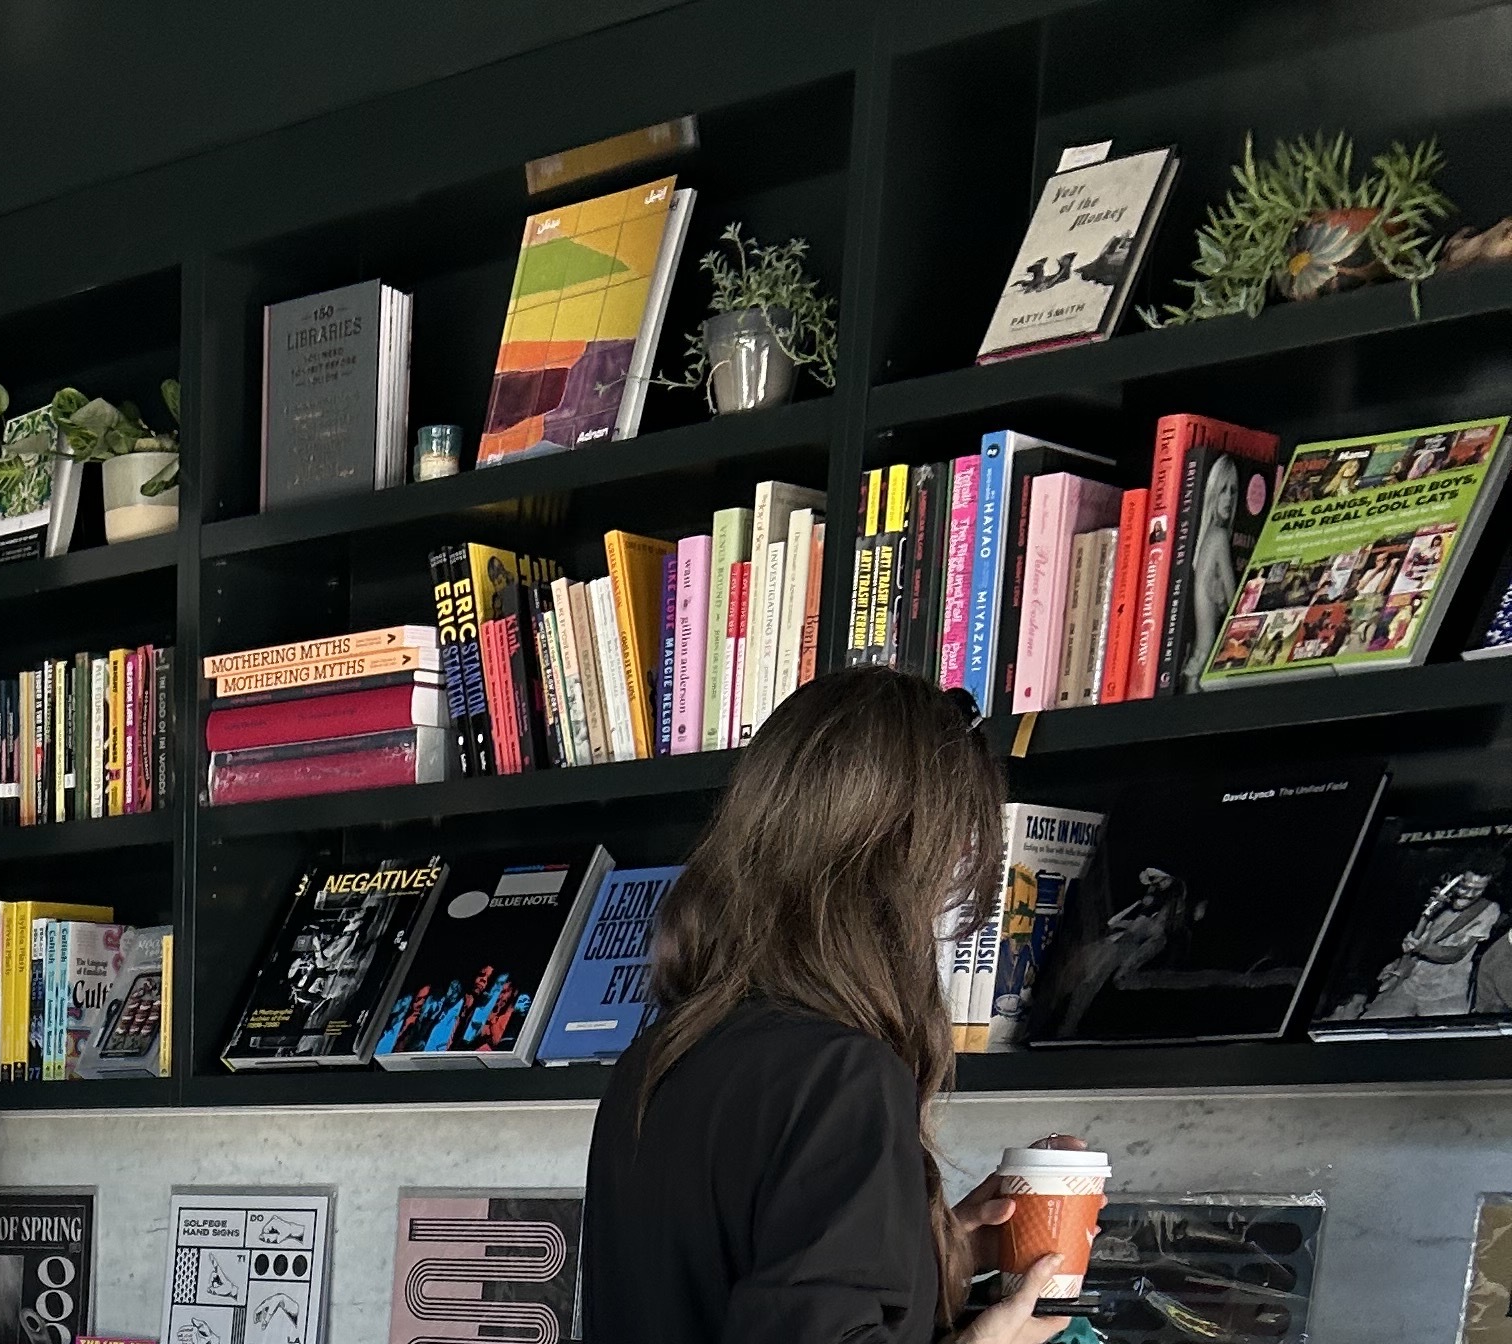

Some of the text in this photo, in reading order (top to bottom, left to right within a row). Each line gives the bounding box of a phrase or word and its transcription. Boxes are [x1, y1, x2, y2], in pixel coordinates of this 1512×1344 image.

[1052, 184, 1086, 204] Year
[1069, 205, 1129, 231] Monkey
[1010, 303, 1086, 326] PATTI SMITH
[287, 317, 363, 350] LIBRARIES
[1271, 474, 1477, 523] GIRL GANGS, BIKER BOYS,
[1279, 489, 1459, 534] AND REAL COOL CATS
[970, 502, 995, 673] HAYAO MIYAZAKI
[211, 638, 351, 674] MOTHERING MYTHS
[434, 582, 466, 719] ERIC STANTON
[453, 578, 486, 716] ERIC STANTON
[661, 560, 677, 743] LIKE LOVE MAGGIE NELSON
[223, 658, 366, 693] MOTHERING MYTHS
[679, 658, 691, 714] anderson
[1026, 815, 1102, 848] TASTE IN MUSIC
[324, 867, 443, 896] NEGATIVES
[489, 894, 556, 907] BLUE NOTE
[975, 921, 1000, 975] MUSIC
[20, 1215, 83, 1243] SPRING
[182, 1228, 240, 1238] HAND SIGNS
[183, 1219, 228, 1229] SOLFEGE
